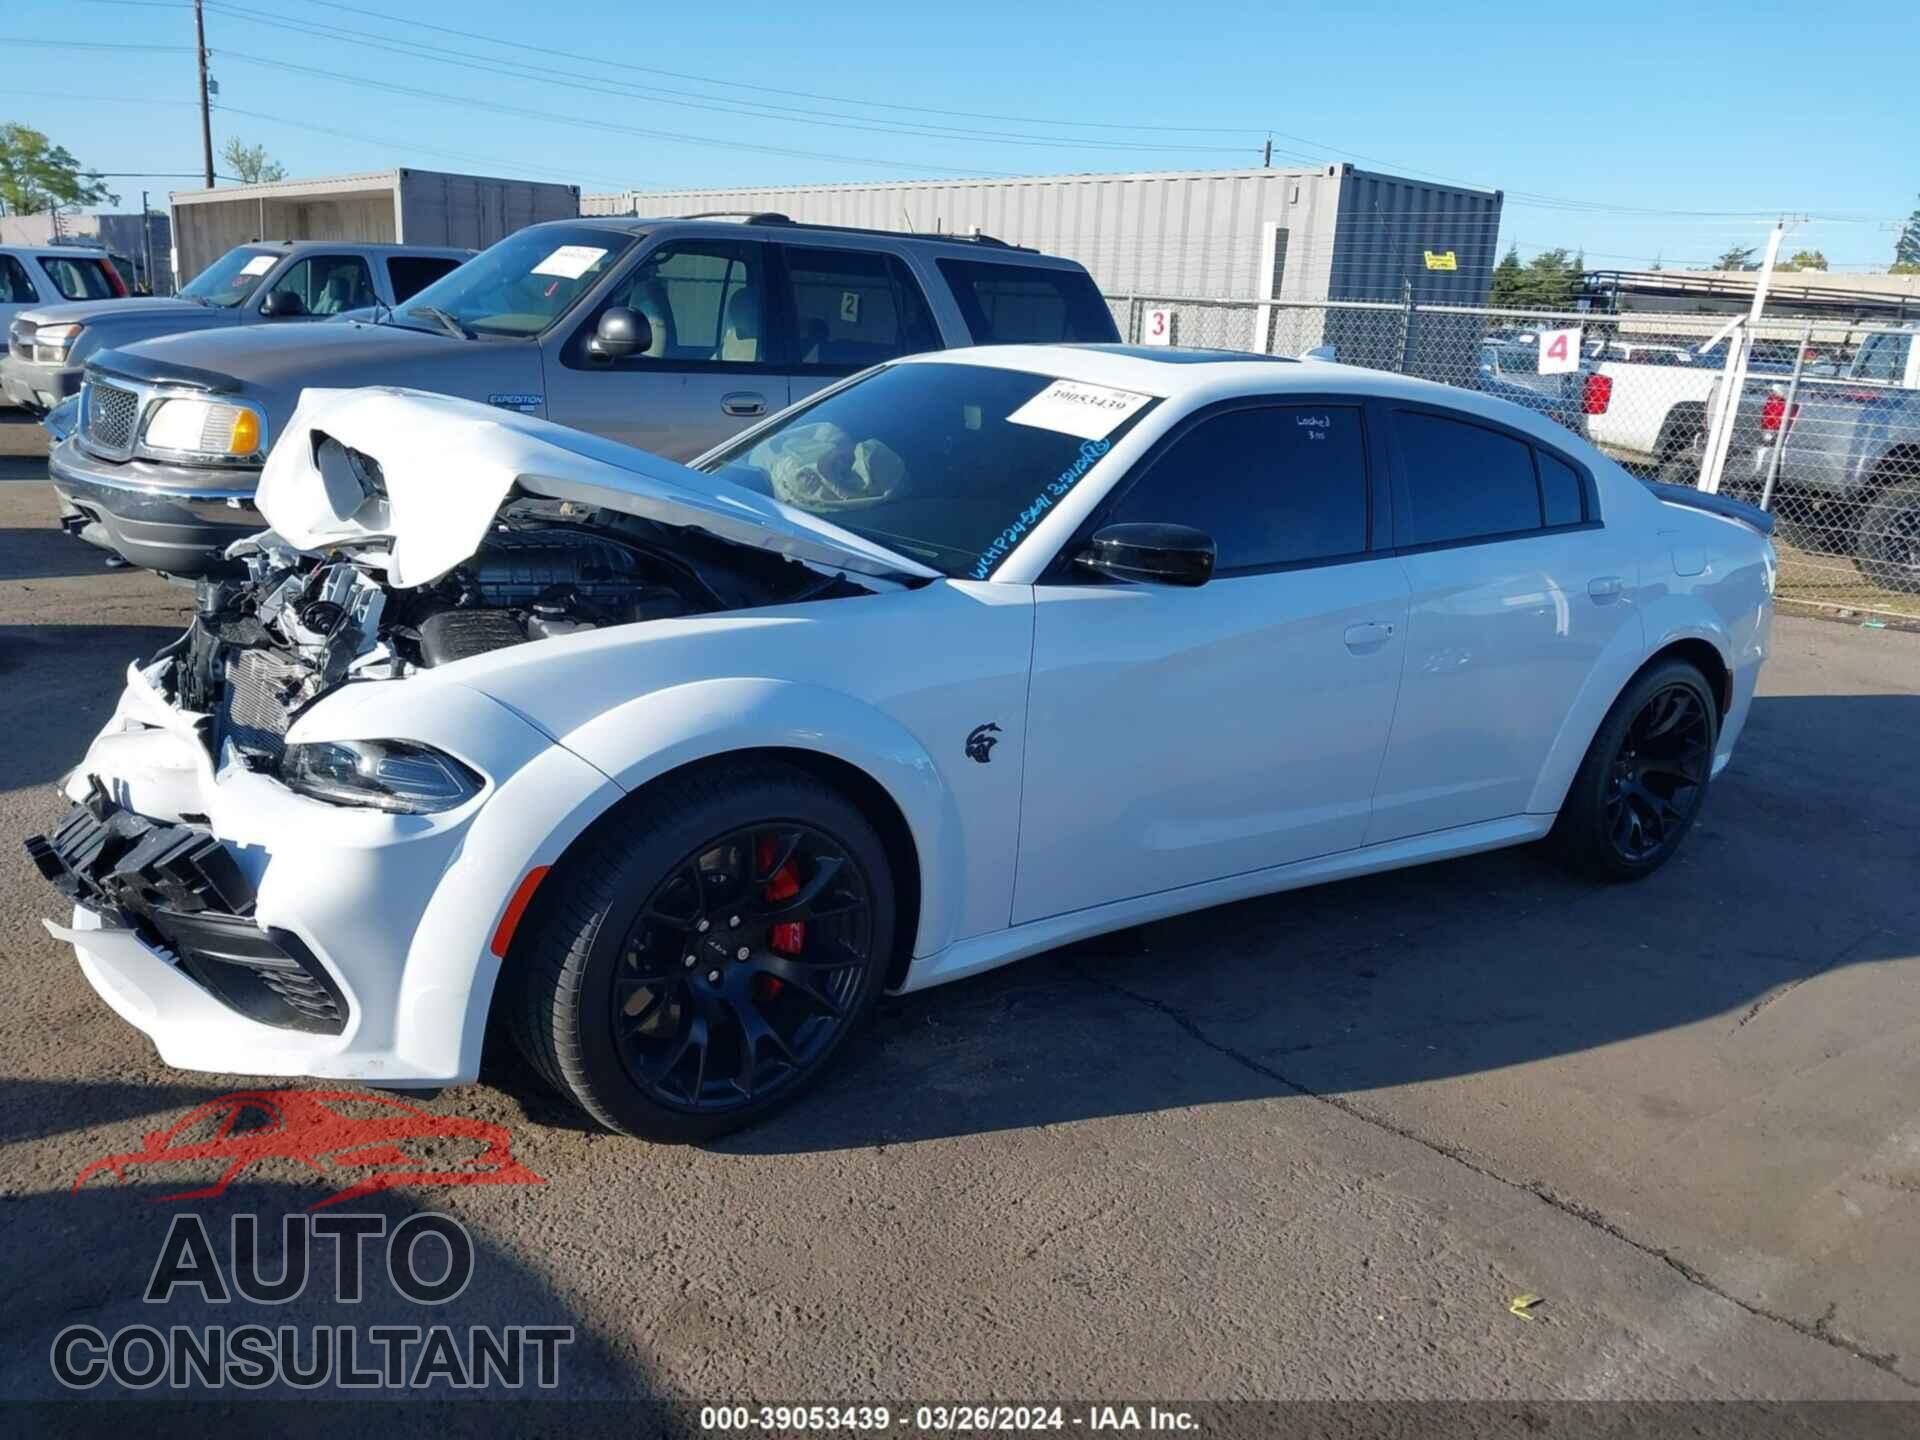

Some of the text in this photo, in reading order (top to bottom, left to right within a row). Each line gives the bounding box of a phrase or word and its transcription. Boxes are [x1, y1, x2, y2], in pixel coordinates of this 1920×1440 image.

[845, 294, 856, 314] 2
[1152, 311, 1165, 336] 3
[1547, 334, 1568, 361] 4
